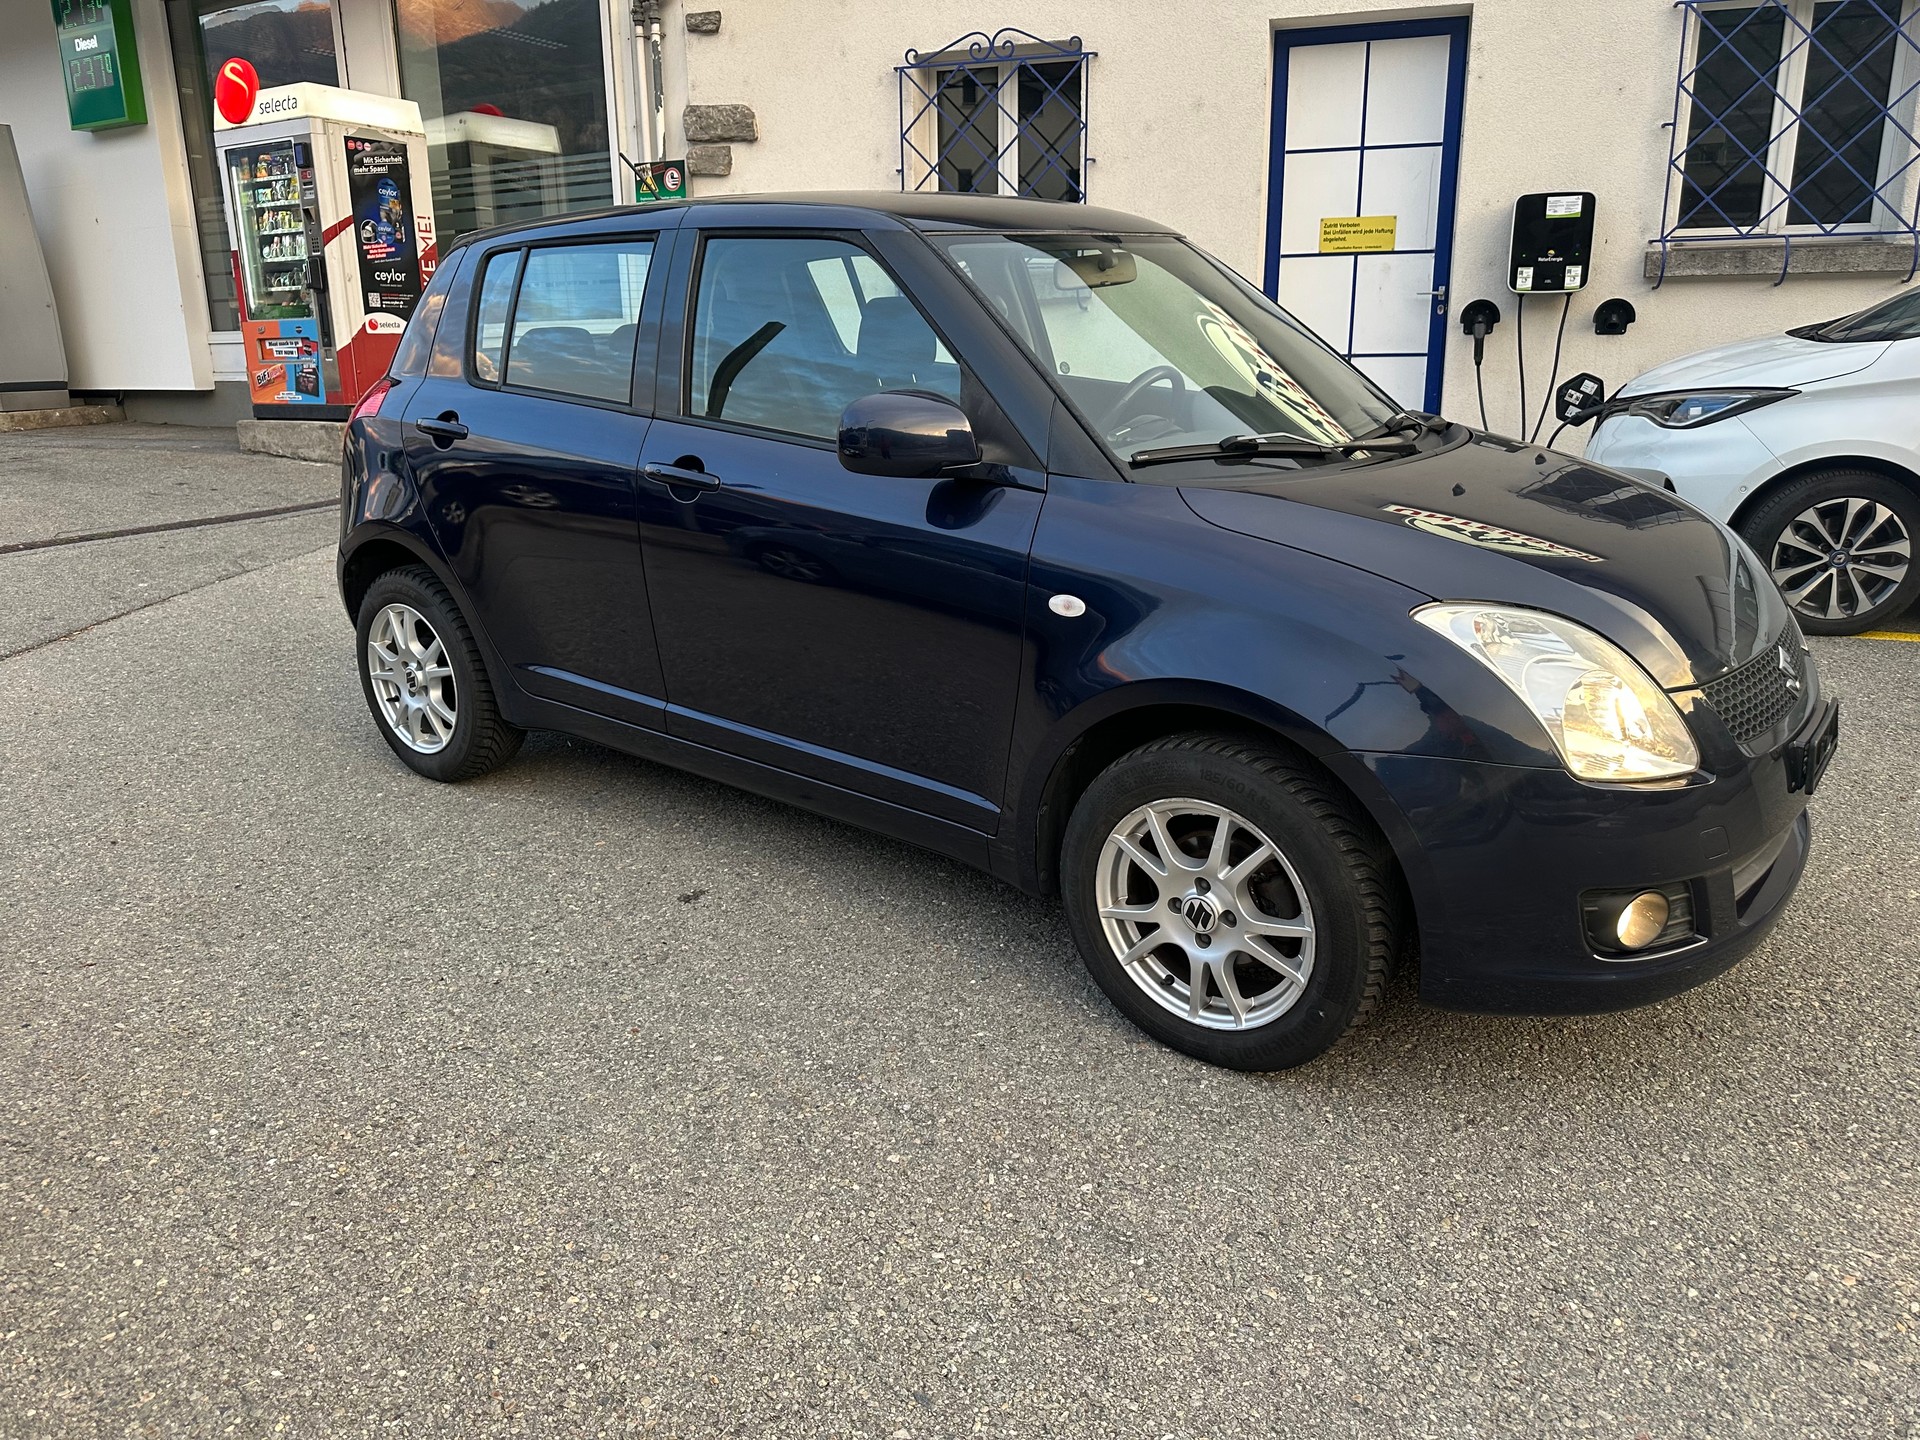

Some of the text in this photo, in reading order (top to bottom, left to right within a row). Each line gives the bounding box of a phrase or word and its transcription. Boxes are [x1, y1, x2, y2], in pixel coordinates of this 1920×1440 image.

[74, 34, 98, 52] Diesel
[259, 94, 298, 115] selecta
[363, 155, 403, 164] Mit Sicherheit
[353, 164, 388, 174] mehr Spass!
[378, 188, 398, 197] ceylor
[374, 268, 406, 284] ceylor
[379, 321, 400, 329] selecta
[1200, 768, 1273, 811] 185/60 R 15
